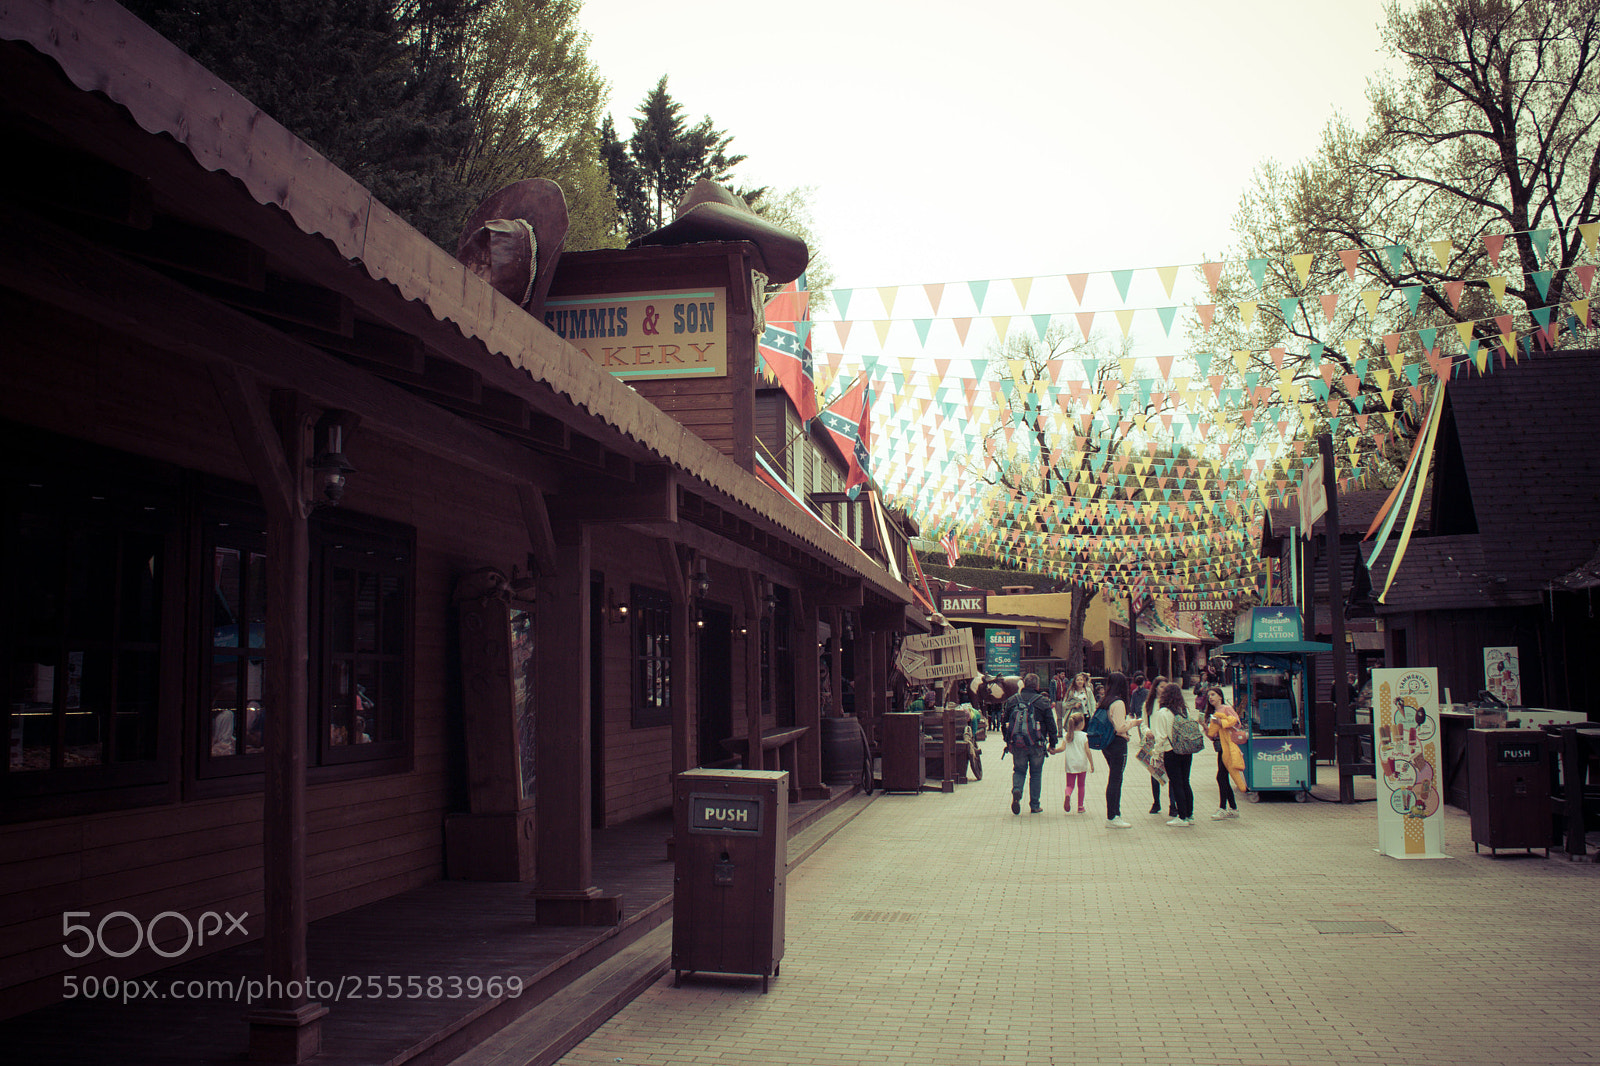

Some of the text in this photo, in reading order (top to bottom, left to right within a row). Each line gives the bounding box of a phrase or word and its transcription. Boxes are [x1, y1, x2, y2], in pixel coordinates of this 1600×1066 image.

[642, 304, 660, 336] &
[673, 302, 715, 334] SON
[942, 598, 982, 611] BANK
[1178, 600, 1234, 611] RIO BRAVO
[1260, 616, 1291, 624] Starslush
[989, 635, 1017, 644] SEA LIFE
[1257, 631, 1295, 639] STATION
[920, 635, 961, 648] WESTERN
[1256, 751, 1303, 762] Starslush
[1503, 749, 1532, 759] PUSH
[704, 806, 749, 823] PUSH
